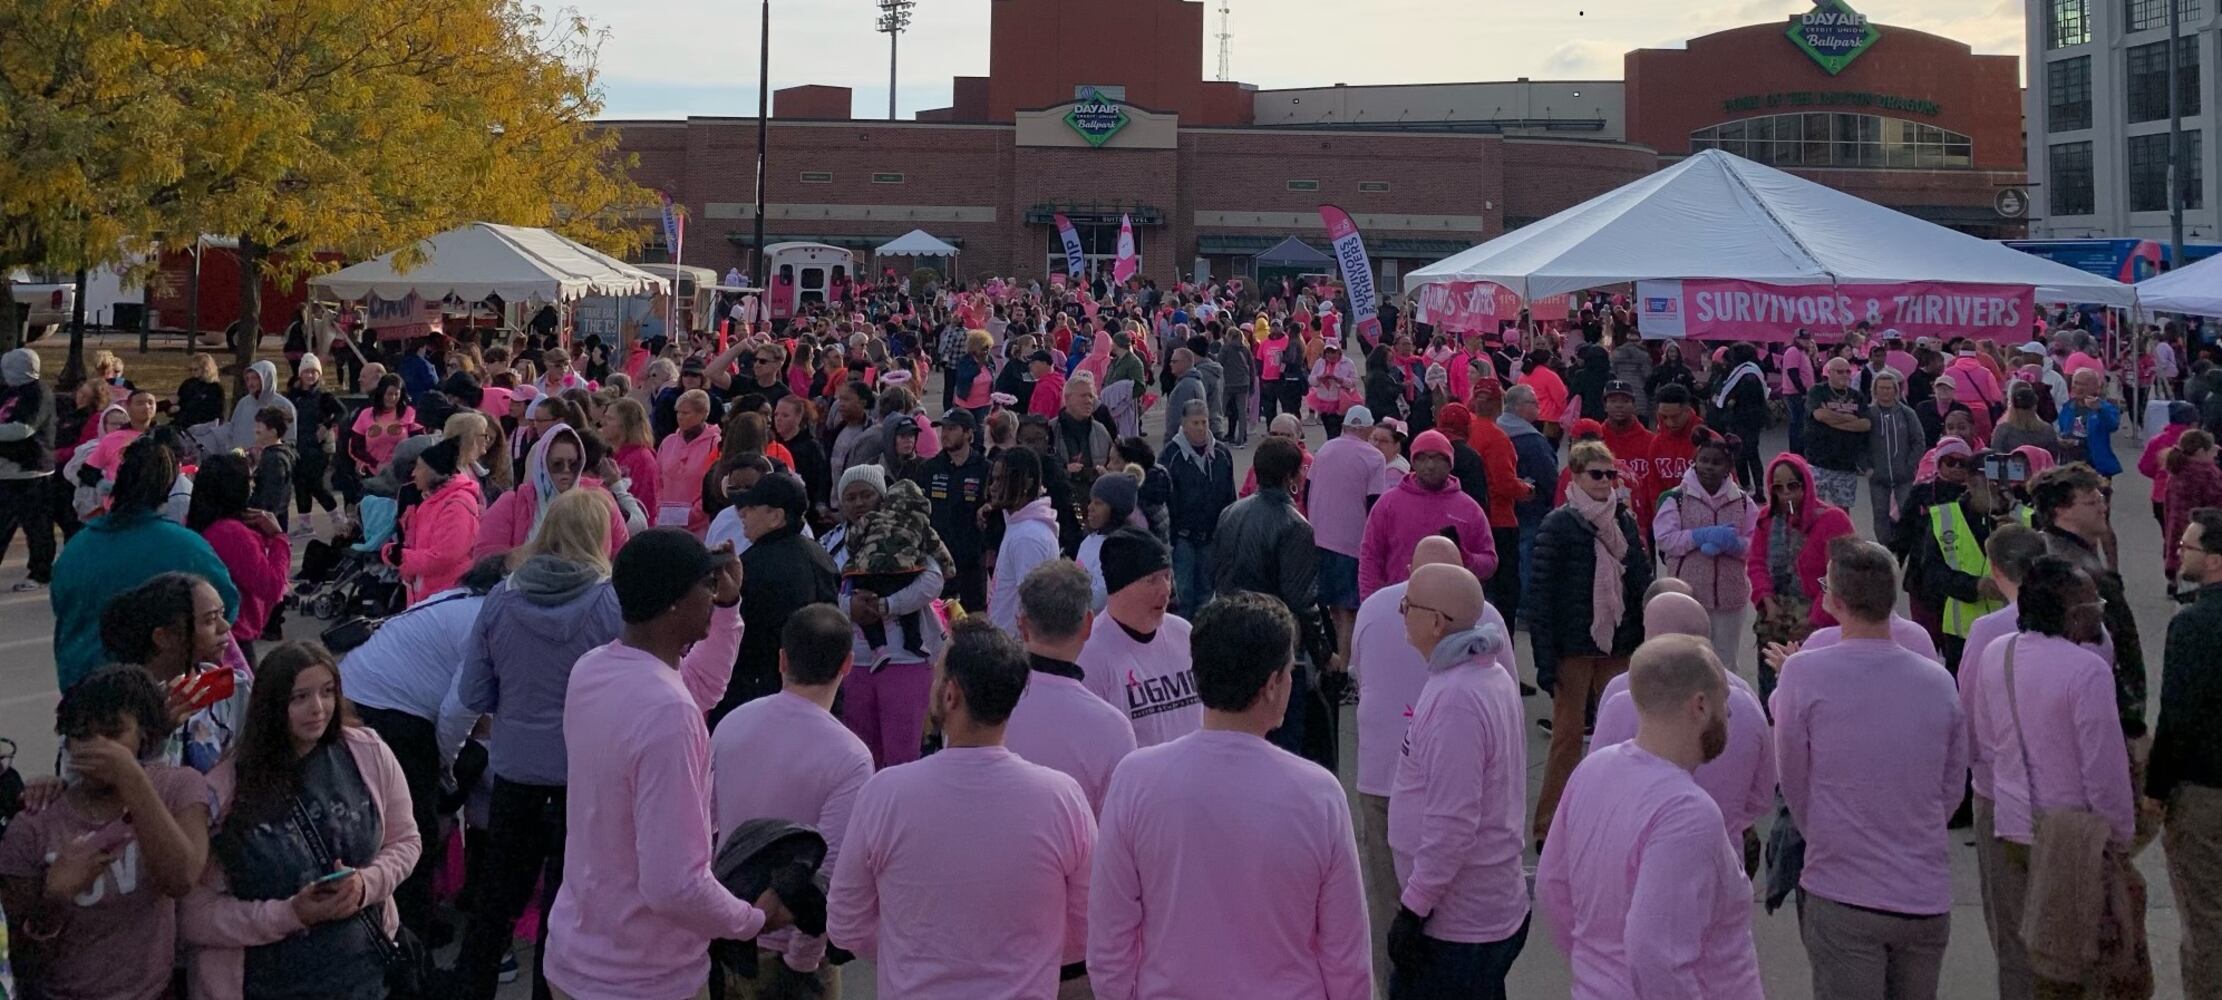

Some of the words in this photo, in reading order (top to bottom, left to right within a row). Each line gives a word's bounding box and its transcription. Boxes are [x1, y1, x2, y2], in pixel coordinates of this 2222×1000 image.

[1806, 34, 1863, 50] Ballpark
[1078, 119, 1116, 131] Ballpark
[1066, 240, 1082, 268] VIP
[1340, 241, 1369, 316] SURVIVORS
[1348, 236, 1374, 304] THRIVERS
[1696, 291, 1856, 325] SURVIVORS
[1866, 298, 1883, 325] &
[1893, 294, 2021, 327] THRIVERS
[1613, 380, 1623, 389] T
